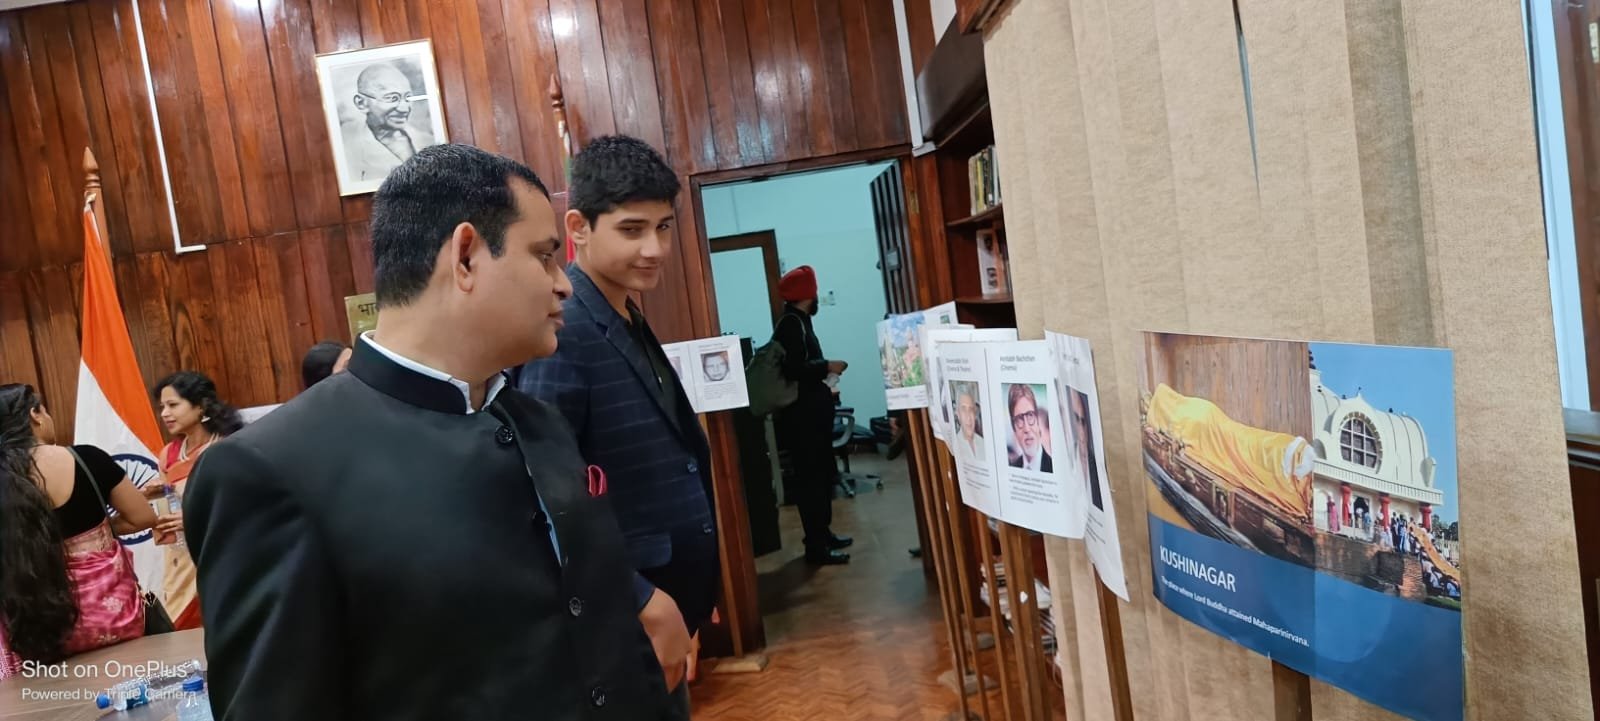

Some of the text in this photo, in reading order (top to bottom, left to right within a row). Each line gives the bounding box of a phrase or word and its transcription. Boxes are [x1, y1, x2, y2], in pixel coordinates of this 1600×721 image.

[1159, 545, 1236, 592] KUSHINAGAR
[1179, 587, 1194, 599] where
[1194, 592, 1206, 604] Lord
[1207, 598, 1228, 613] Buddha
[1228, 608, 1252, 624] attained
